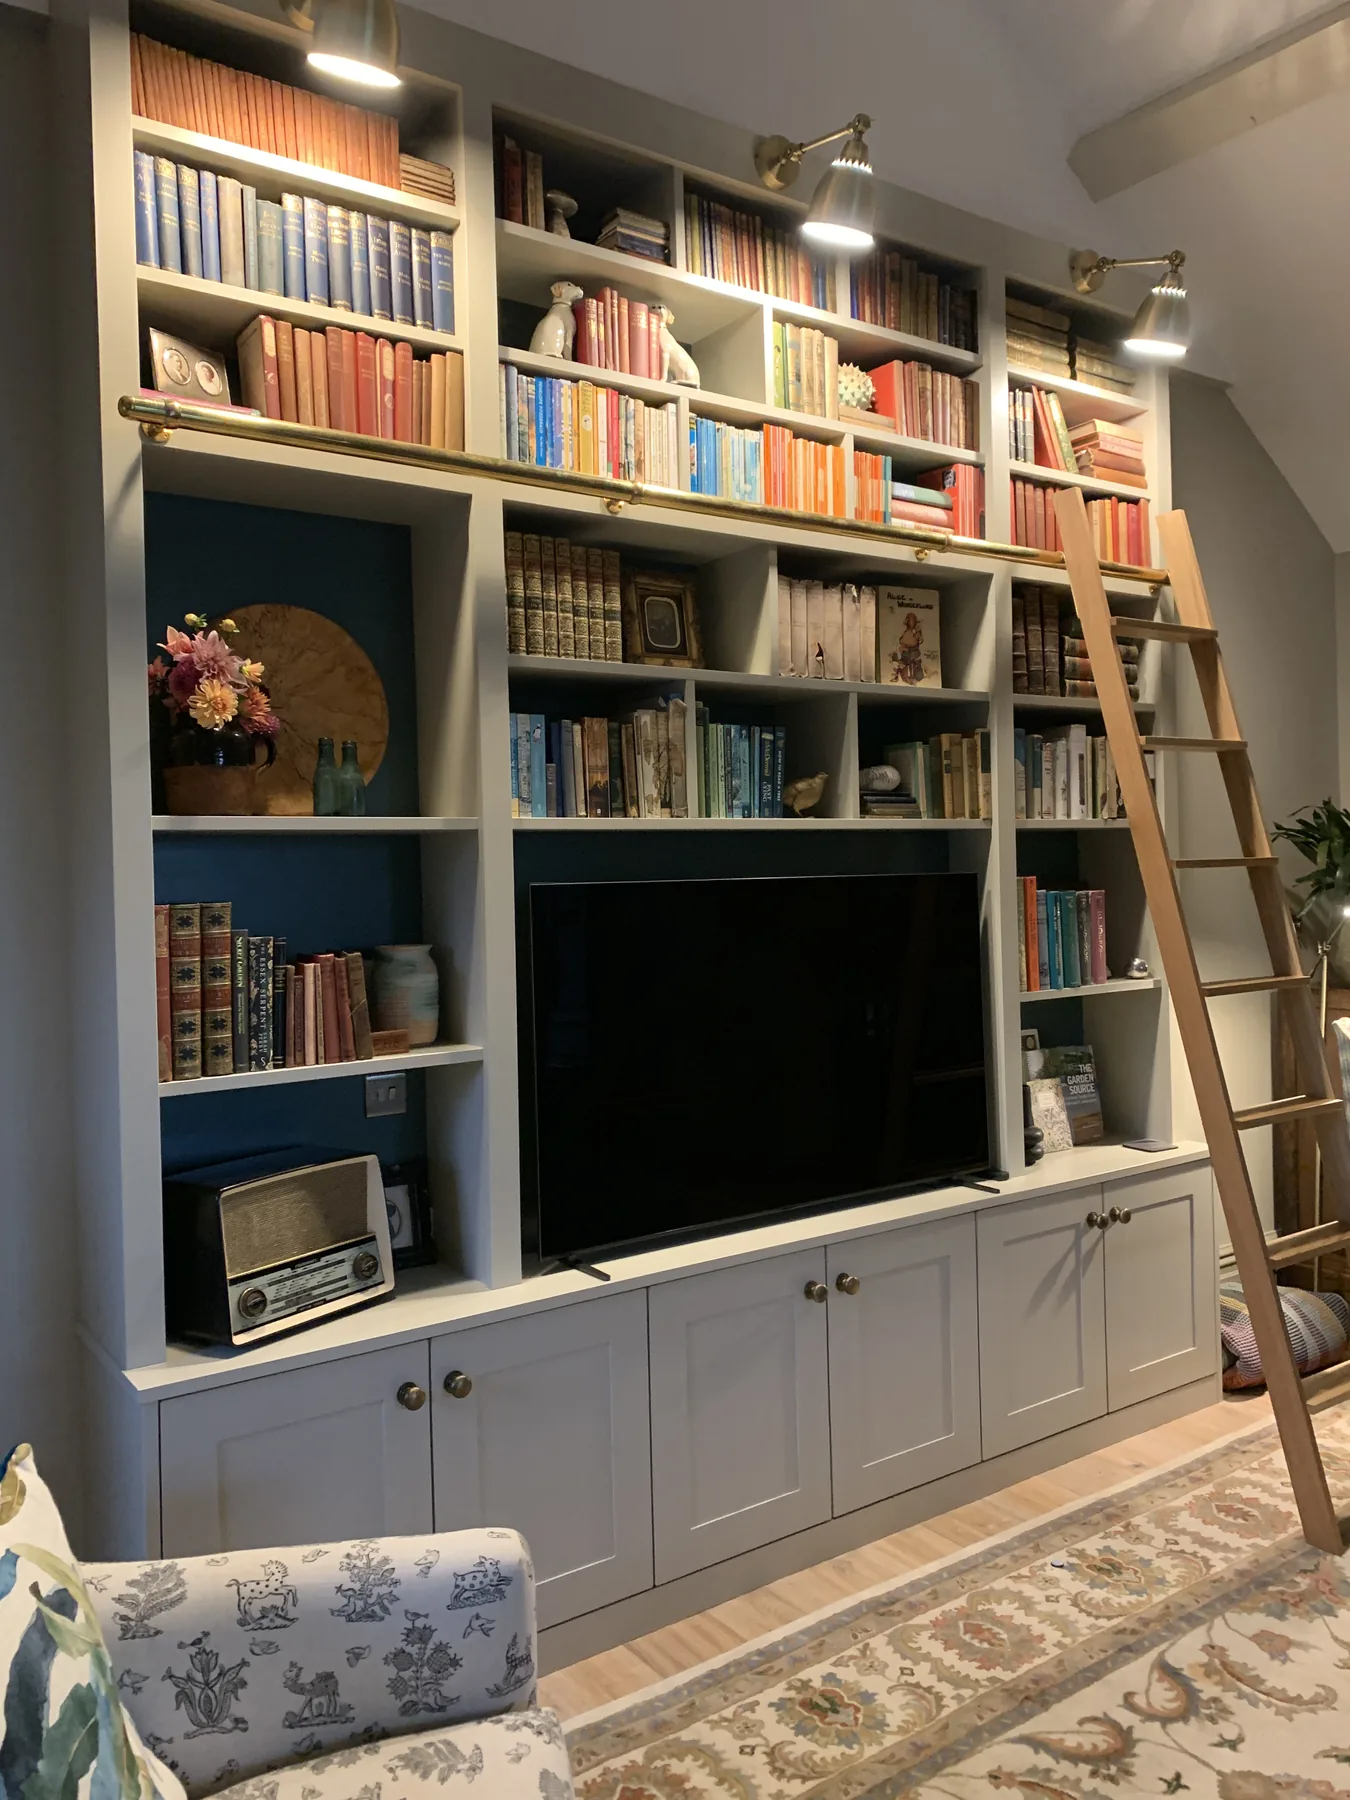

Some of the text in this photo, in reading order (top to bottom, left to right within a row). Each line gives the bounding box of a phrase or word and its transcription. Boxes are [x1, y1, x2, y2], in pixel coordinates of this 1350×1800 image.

[897, 601, 934, 610] WONDERLAND
[235, 961, 246, 988] GARDEN
[1078, 1064, 1092, 1073] THE
[1067, 1074, 1094, 1085] GARDEN
[1069, 1083, 1095, 1095] SOURCE
